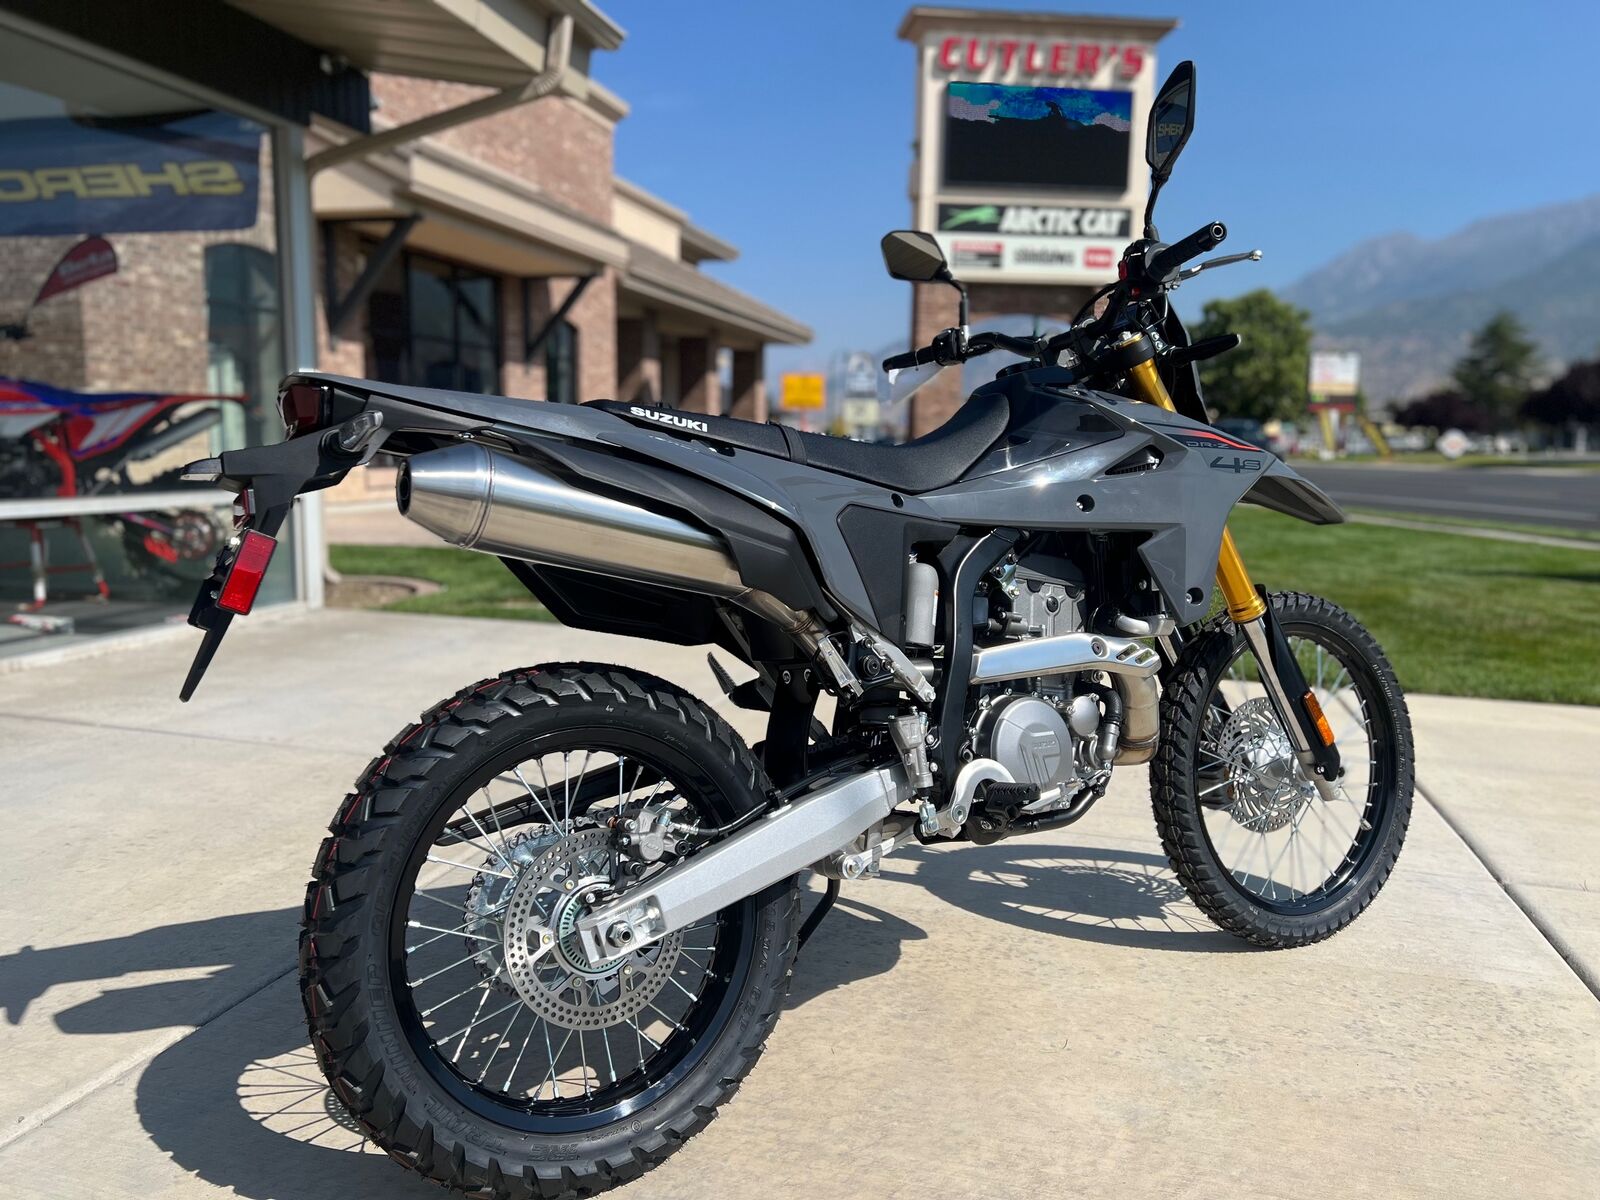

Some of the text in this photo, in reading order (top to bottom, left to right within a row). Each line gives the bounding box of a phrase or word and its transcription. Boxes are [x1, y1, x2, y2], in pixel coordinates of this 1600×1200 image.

[938, 36, 1145, 78] CUTLER'S
[998, 206, 1128, 237] ARCTIC CAT
[630, 406, 708, 433] SUZUKI
[1209, 456, 1262, 474] 4S
